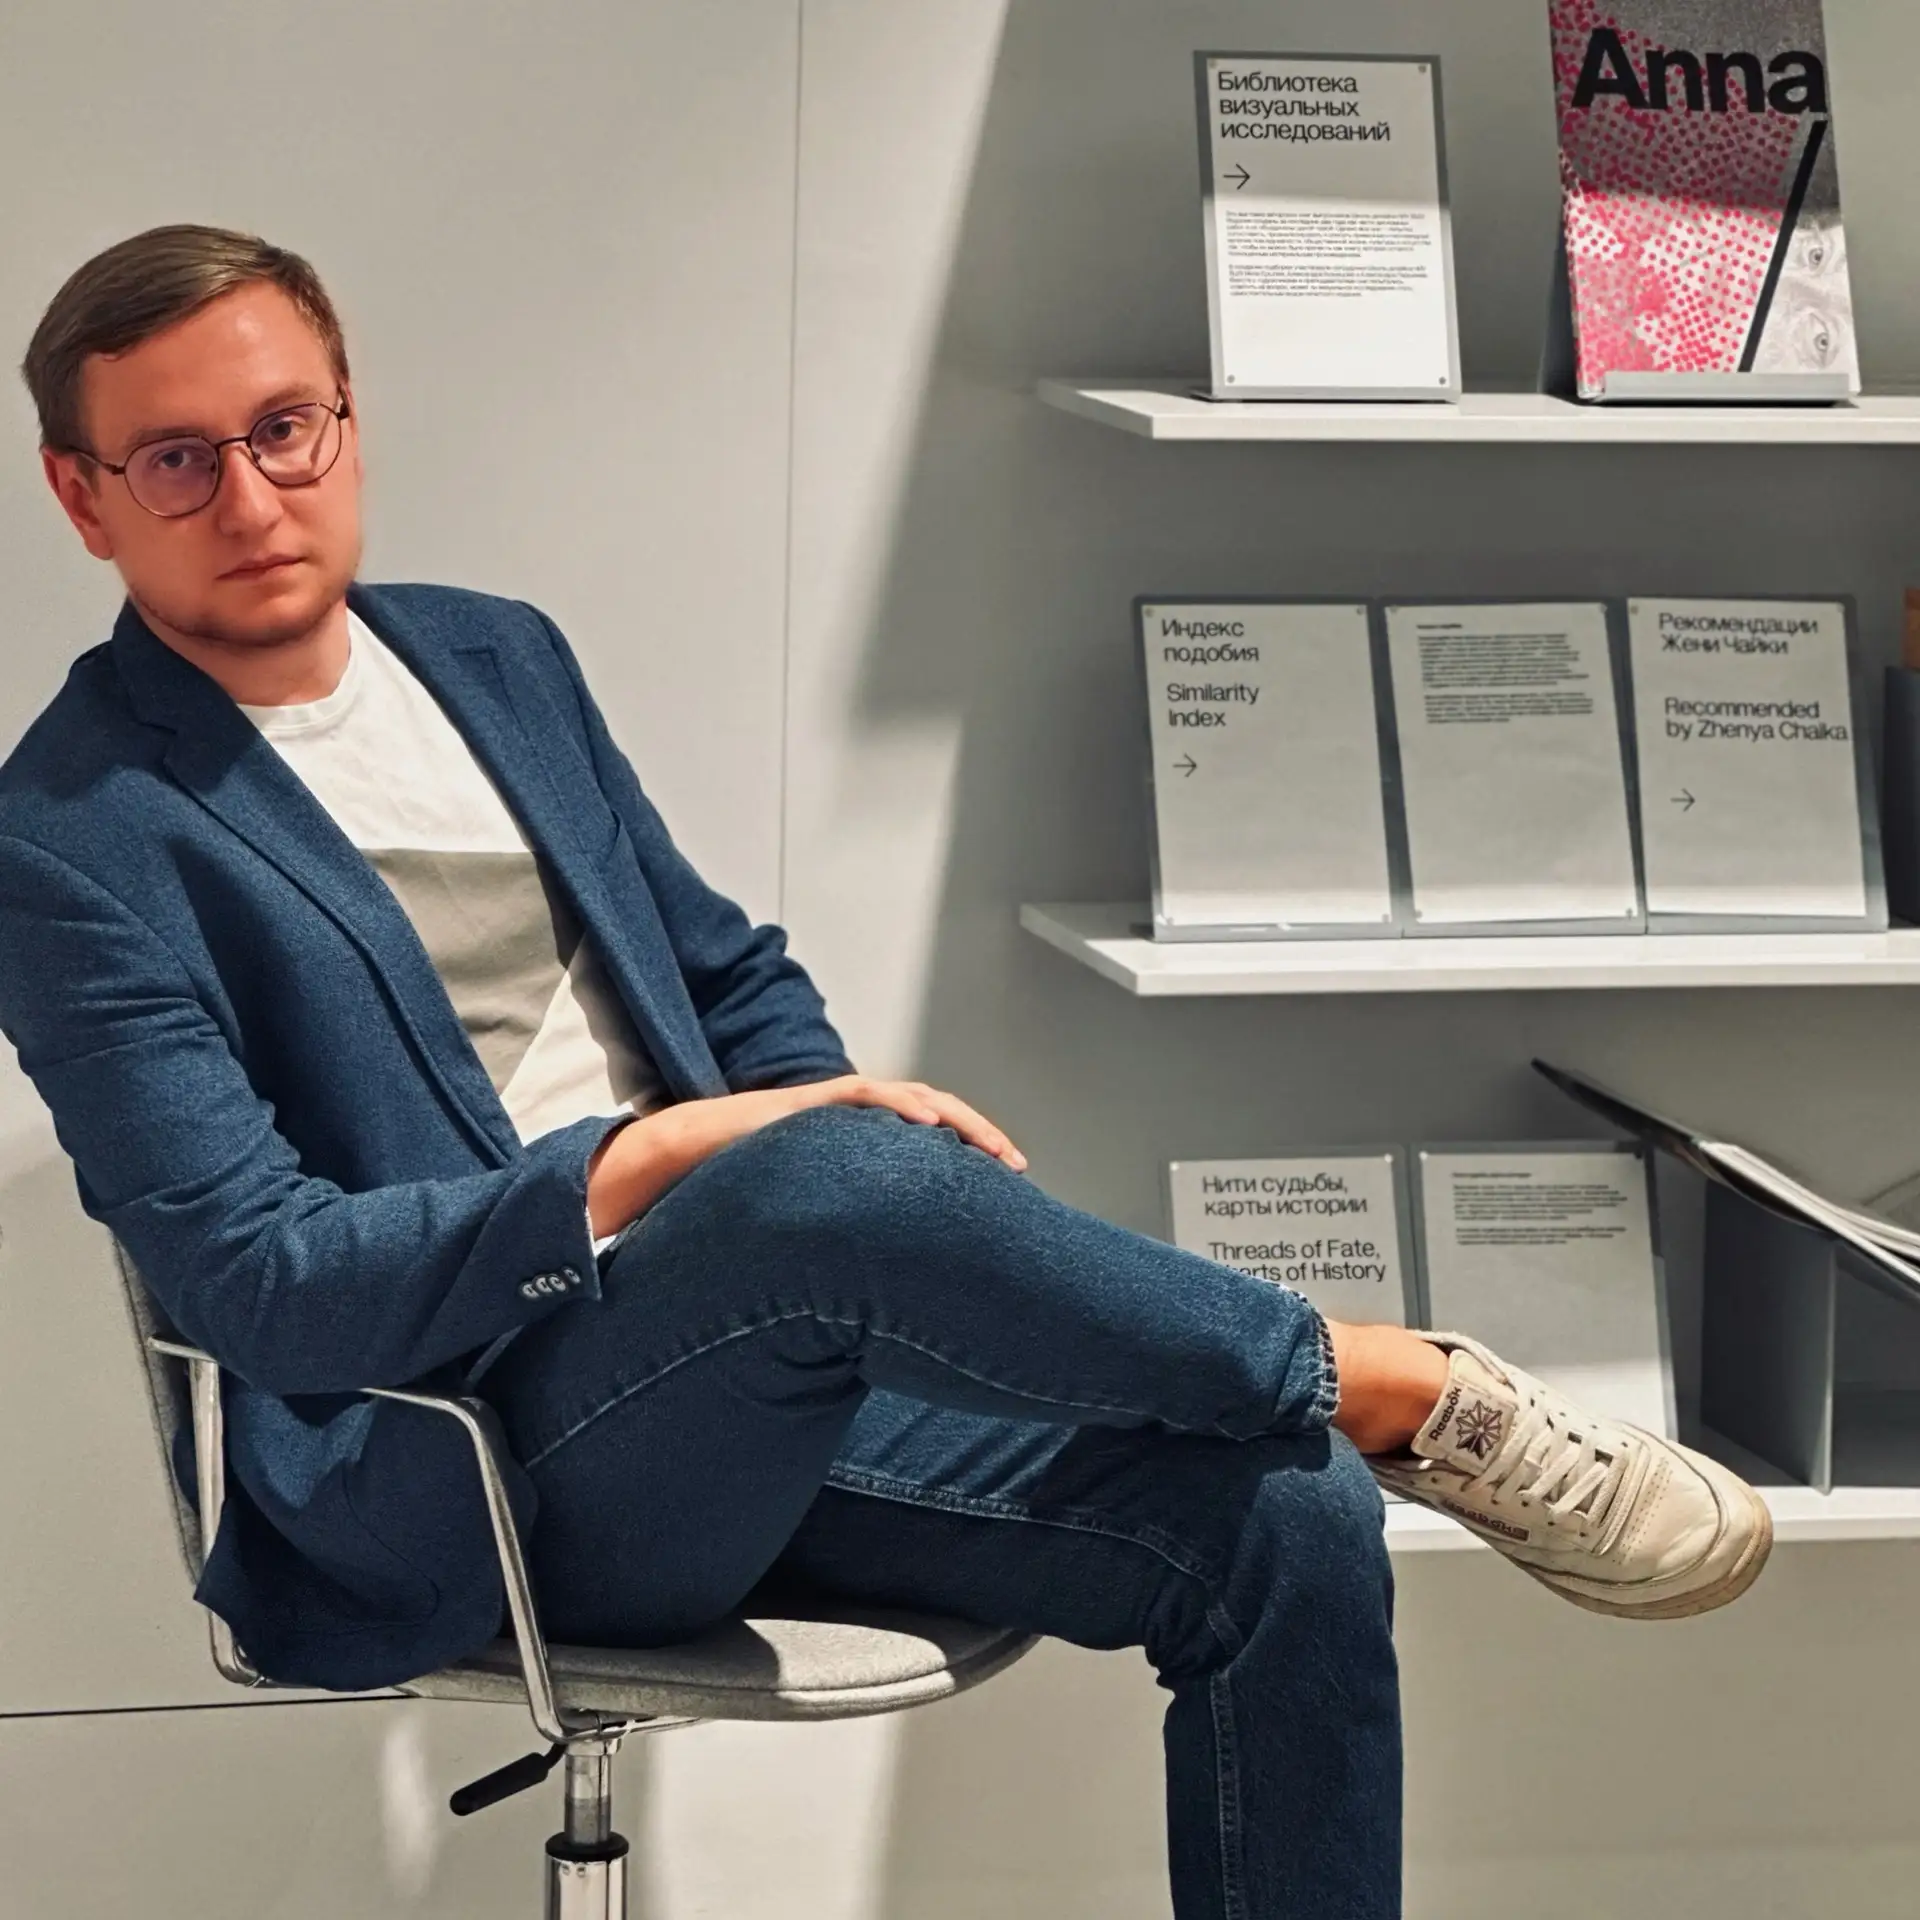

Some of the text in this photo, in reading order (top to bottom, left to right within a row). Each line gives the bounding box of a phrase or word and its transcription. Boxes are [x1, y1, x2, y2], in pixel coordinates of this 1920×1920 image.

[1571, 27, 1828, 114] Anna
[1217, 71, 1358, 93] Библиотека
[1219, 98, 1360, 119] визуальных
[1220, 122, 1391, 143] исследований
[1161, 618, 1245, 640] Индекс
[1658, 612, 1819, 637] Рекомендации
[1163, 643, 1260, 666] подобия
[1661, 634, 1789, 655] Жени Чайки
[1166, 683, 1260, 705] Similarity
[1168, 709, 1226, 727] Index
[1664, 697, 1820, 719] Recommended
[1666, 719, 1692, 741] by
[1698, 719, 1775, 743] Zhenya
[1203, 1172, 1349, 1197] Нити судьбы,
[1205, 1198, 1368, 1219] карты истории
[1209, 1239, 1381, 1260] Threads of Fate,
[1286, 1263, 1307, 1282] of
[1312, 1262, 1387, 1283] History
[1428, 1386, 1462, 1442] Reebok
